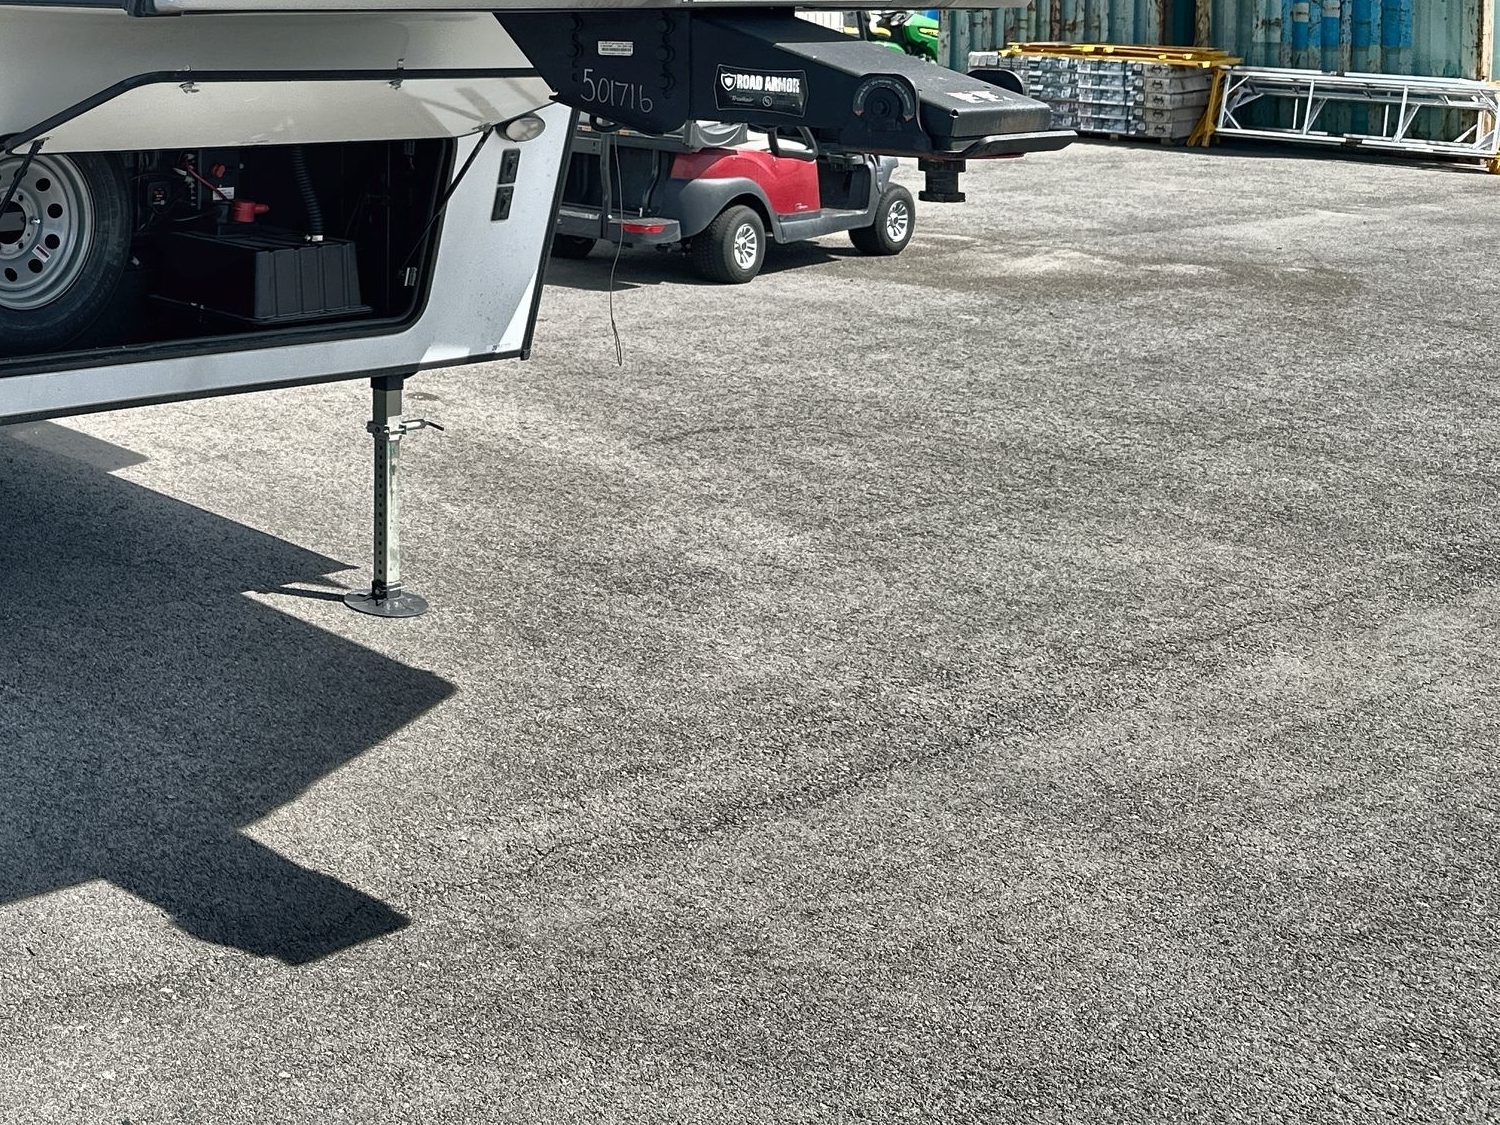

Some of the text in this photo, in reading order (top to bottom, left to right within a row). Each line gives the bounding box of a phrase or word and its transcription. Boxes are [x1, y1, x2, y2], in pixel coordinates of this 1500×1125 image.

[580, 68, 653, 113] 501716
[736, 73, 801, 94] ROAD ARMOR
